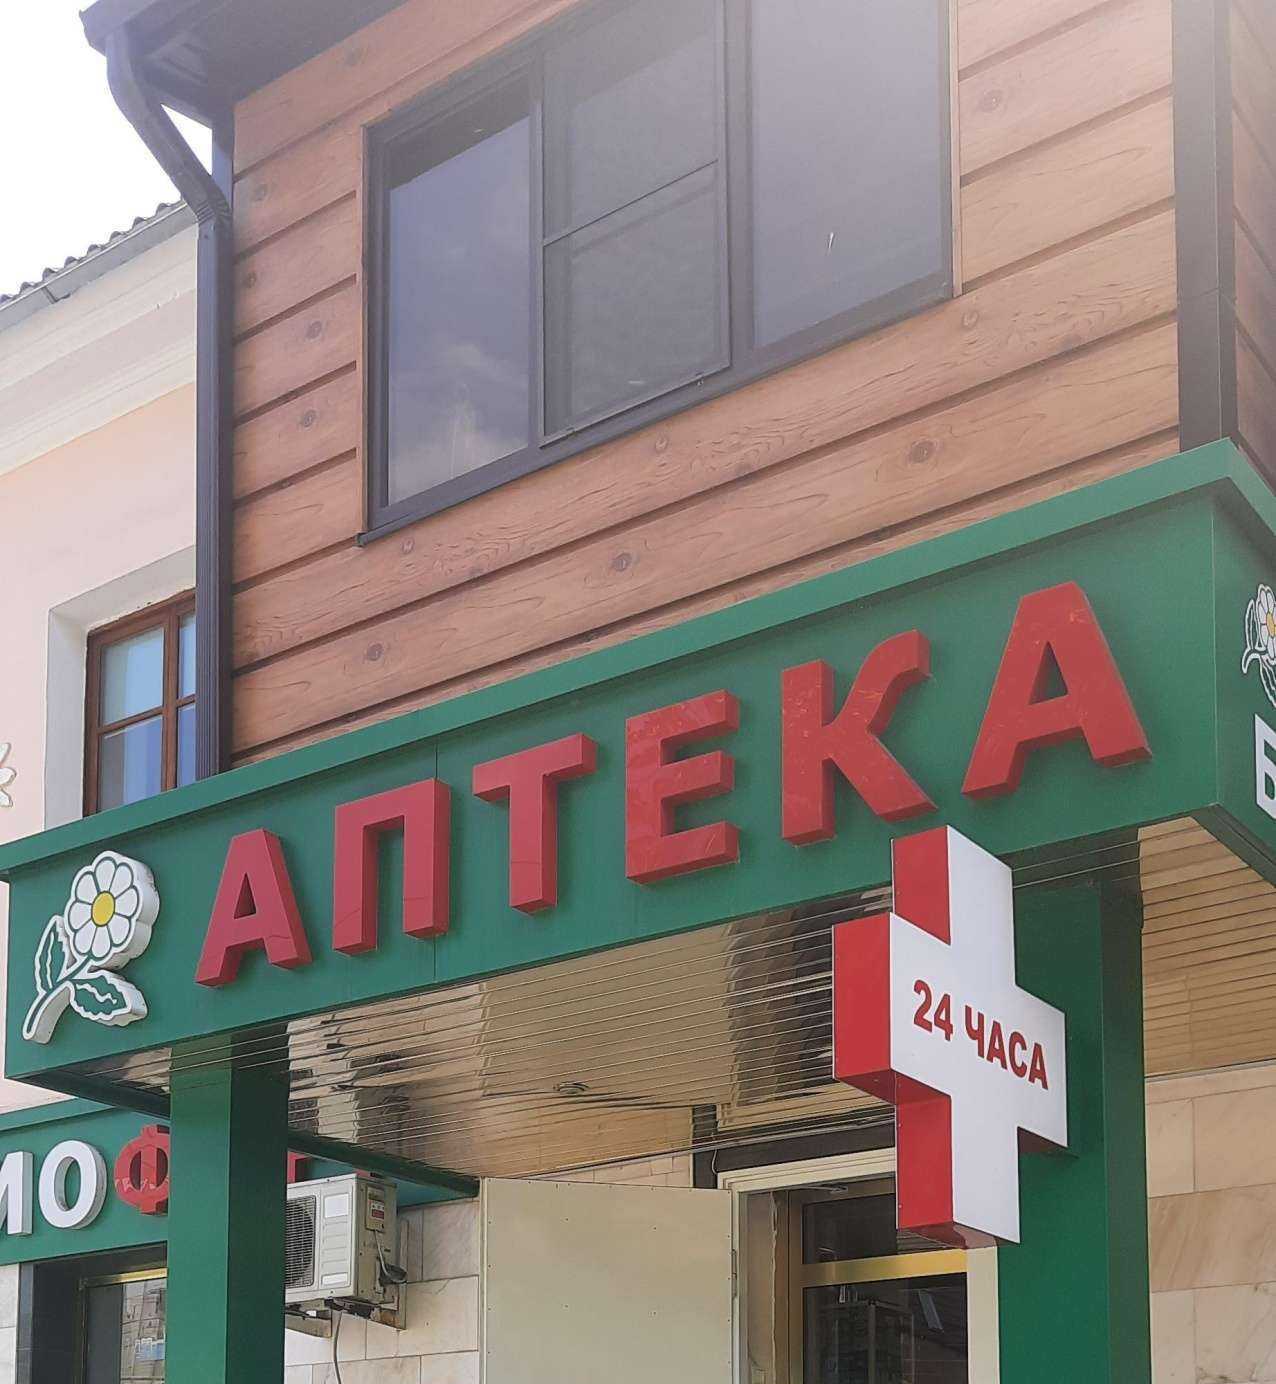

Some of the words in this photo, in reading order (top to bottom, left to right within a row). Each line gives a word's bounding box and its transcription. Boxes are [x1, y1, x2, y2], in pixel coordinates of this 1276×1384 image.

[194, 580, 1152, 988] АПТЕКА
[913, 979, 954, 1042] 24
[964, 1004, 1049, 1091] ЧАСА
